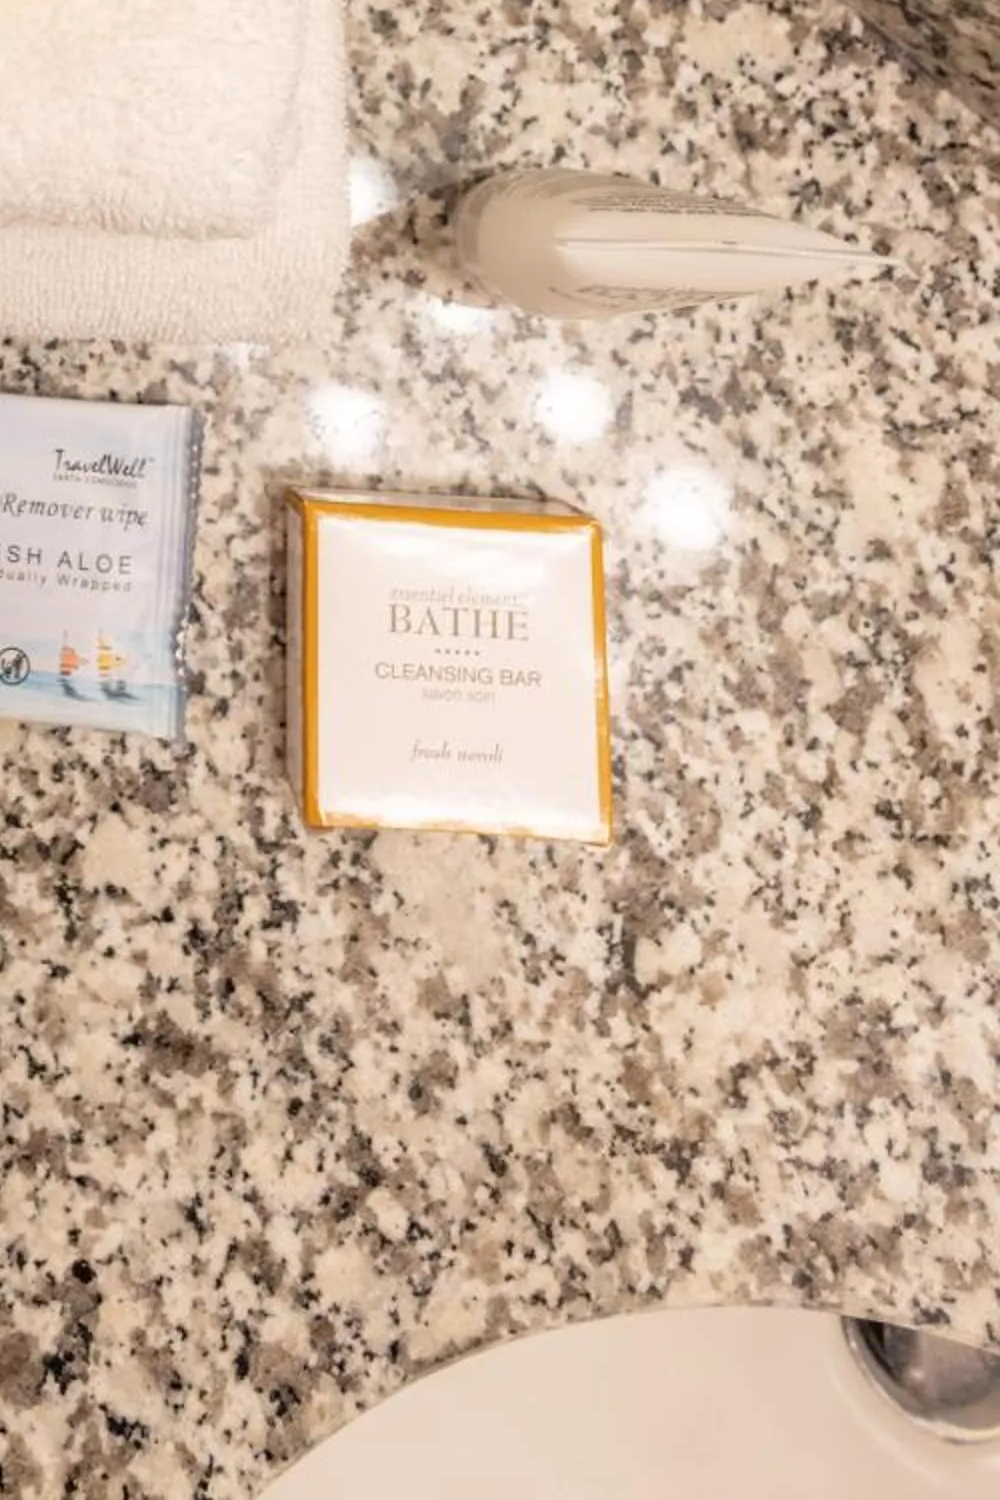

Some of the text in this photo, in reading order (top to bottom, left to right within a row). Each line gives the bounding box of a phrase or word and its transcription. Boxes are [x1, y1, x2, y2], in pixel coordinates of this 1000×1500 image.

[55, 448, 146, 479] TravelWell
[0, 492, 95, 519] Remover
[99, 507, 149, 531] wipe
[56, 550, 133, 575] ALOE
[56, 574, 133, 594] Wrapped
[388, 603, 530, 642] BATHE
[374, 662, 543, 687] CLEANSING BAR
